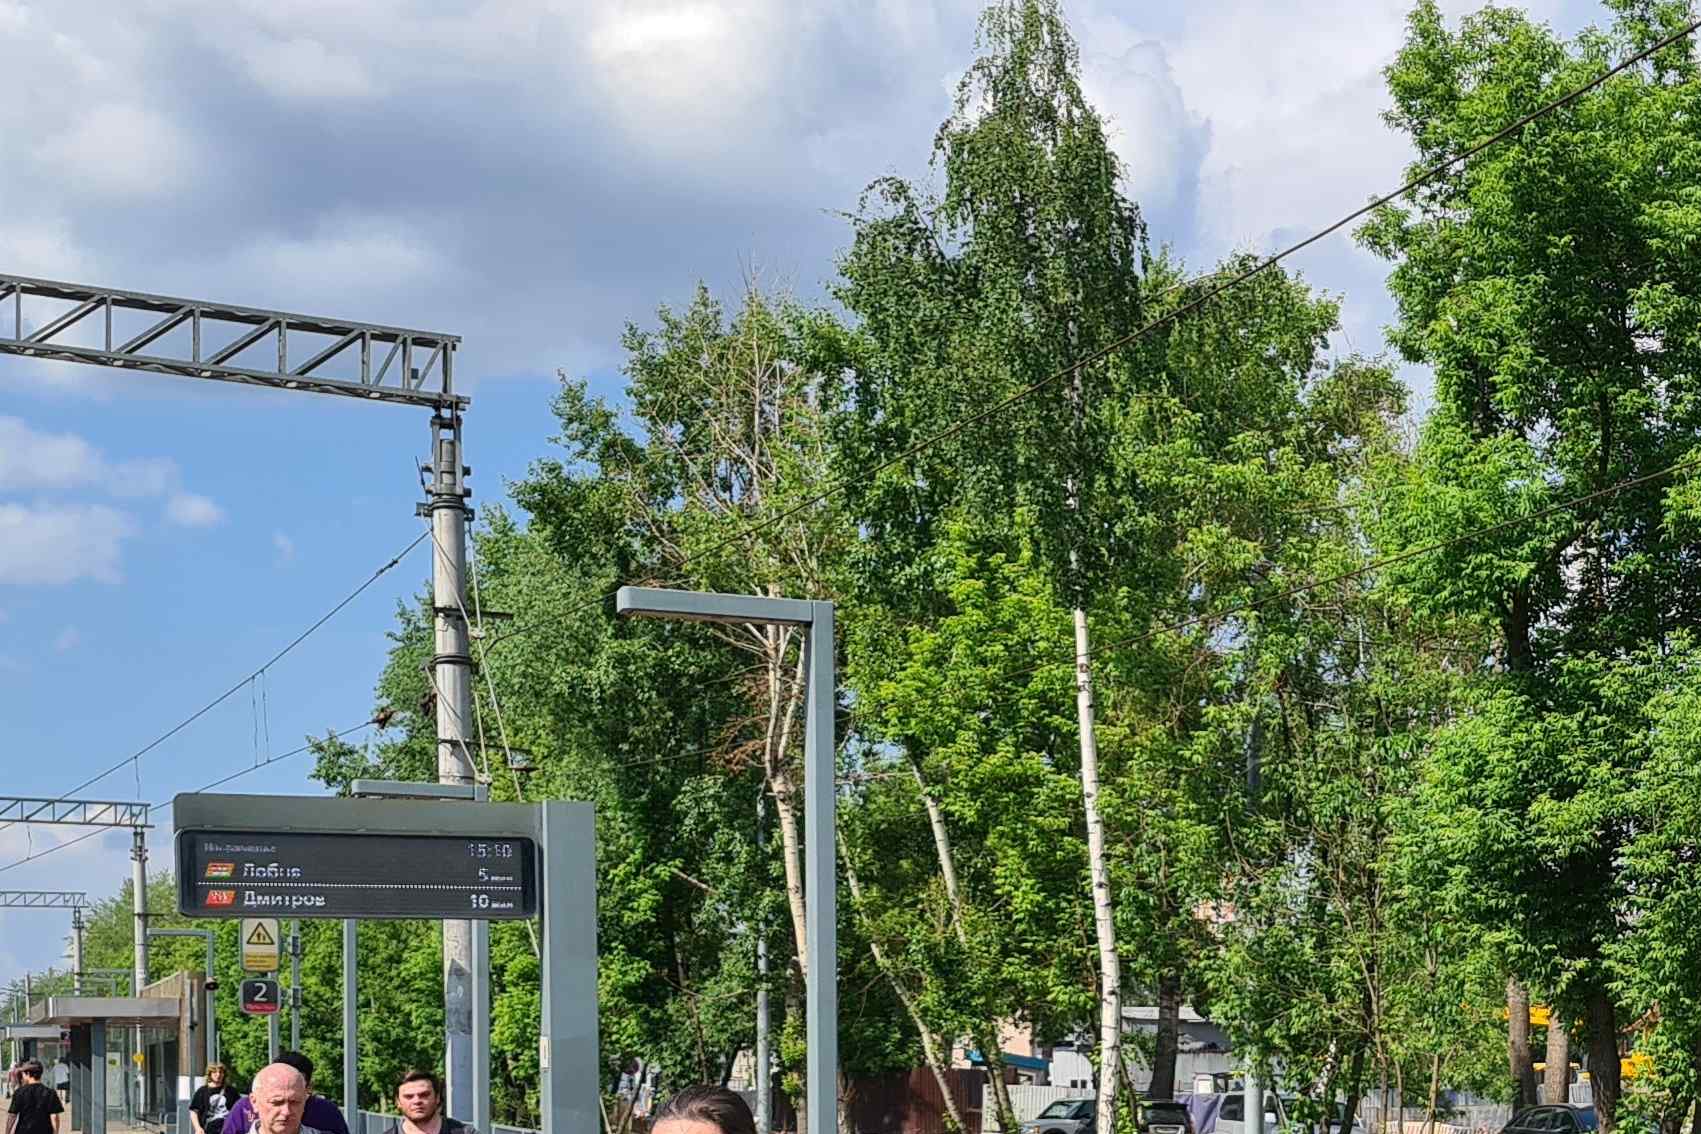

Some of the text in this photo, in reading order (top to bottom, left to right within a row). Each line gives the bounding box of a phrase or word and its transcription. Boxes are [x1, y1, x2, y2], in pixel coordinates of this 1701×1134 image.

[479, 869, 488, 880] 5
[243, 890, 326, 909] Дмитров
[471, 894, 489, 908] 10
[253, 983, 268, 1001] 2
